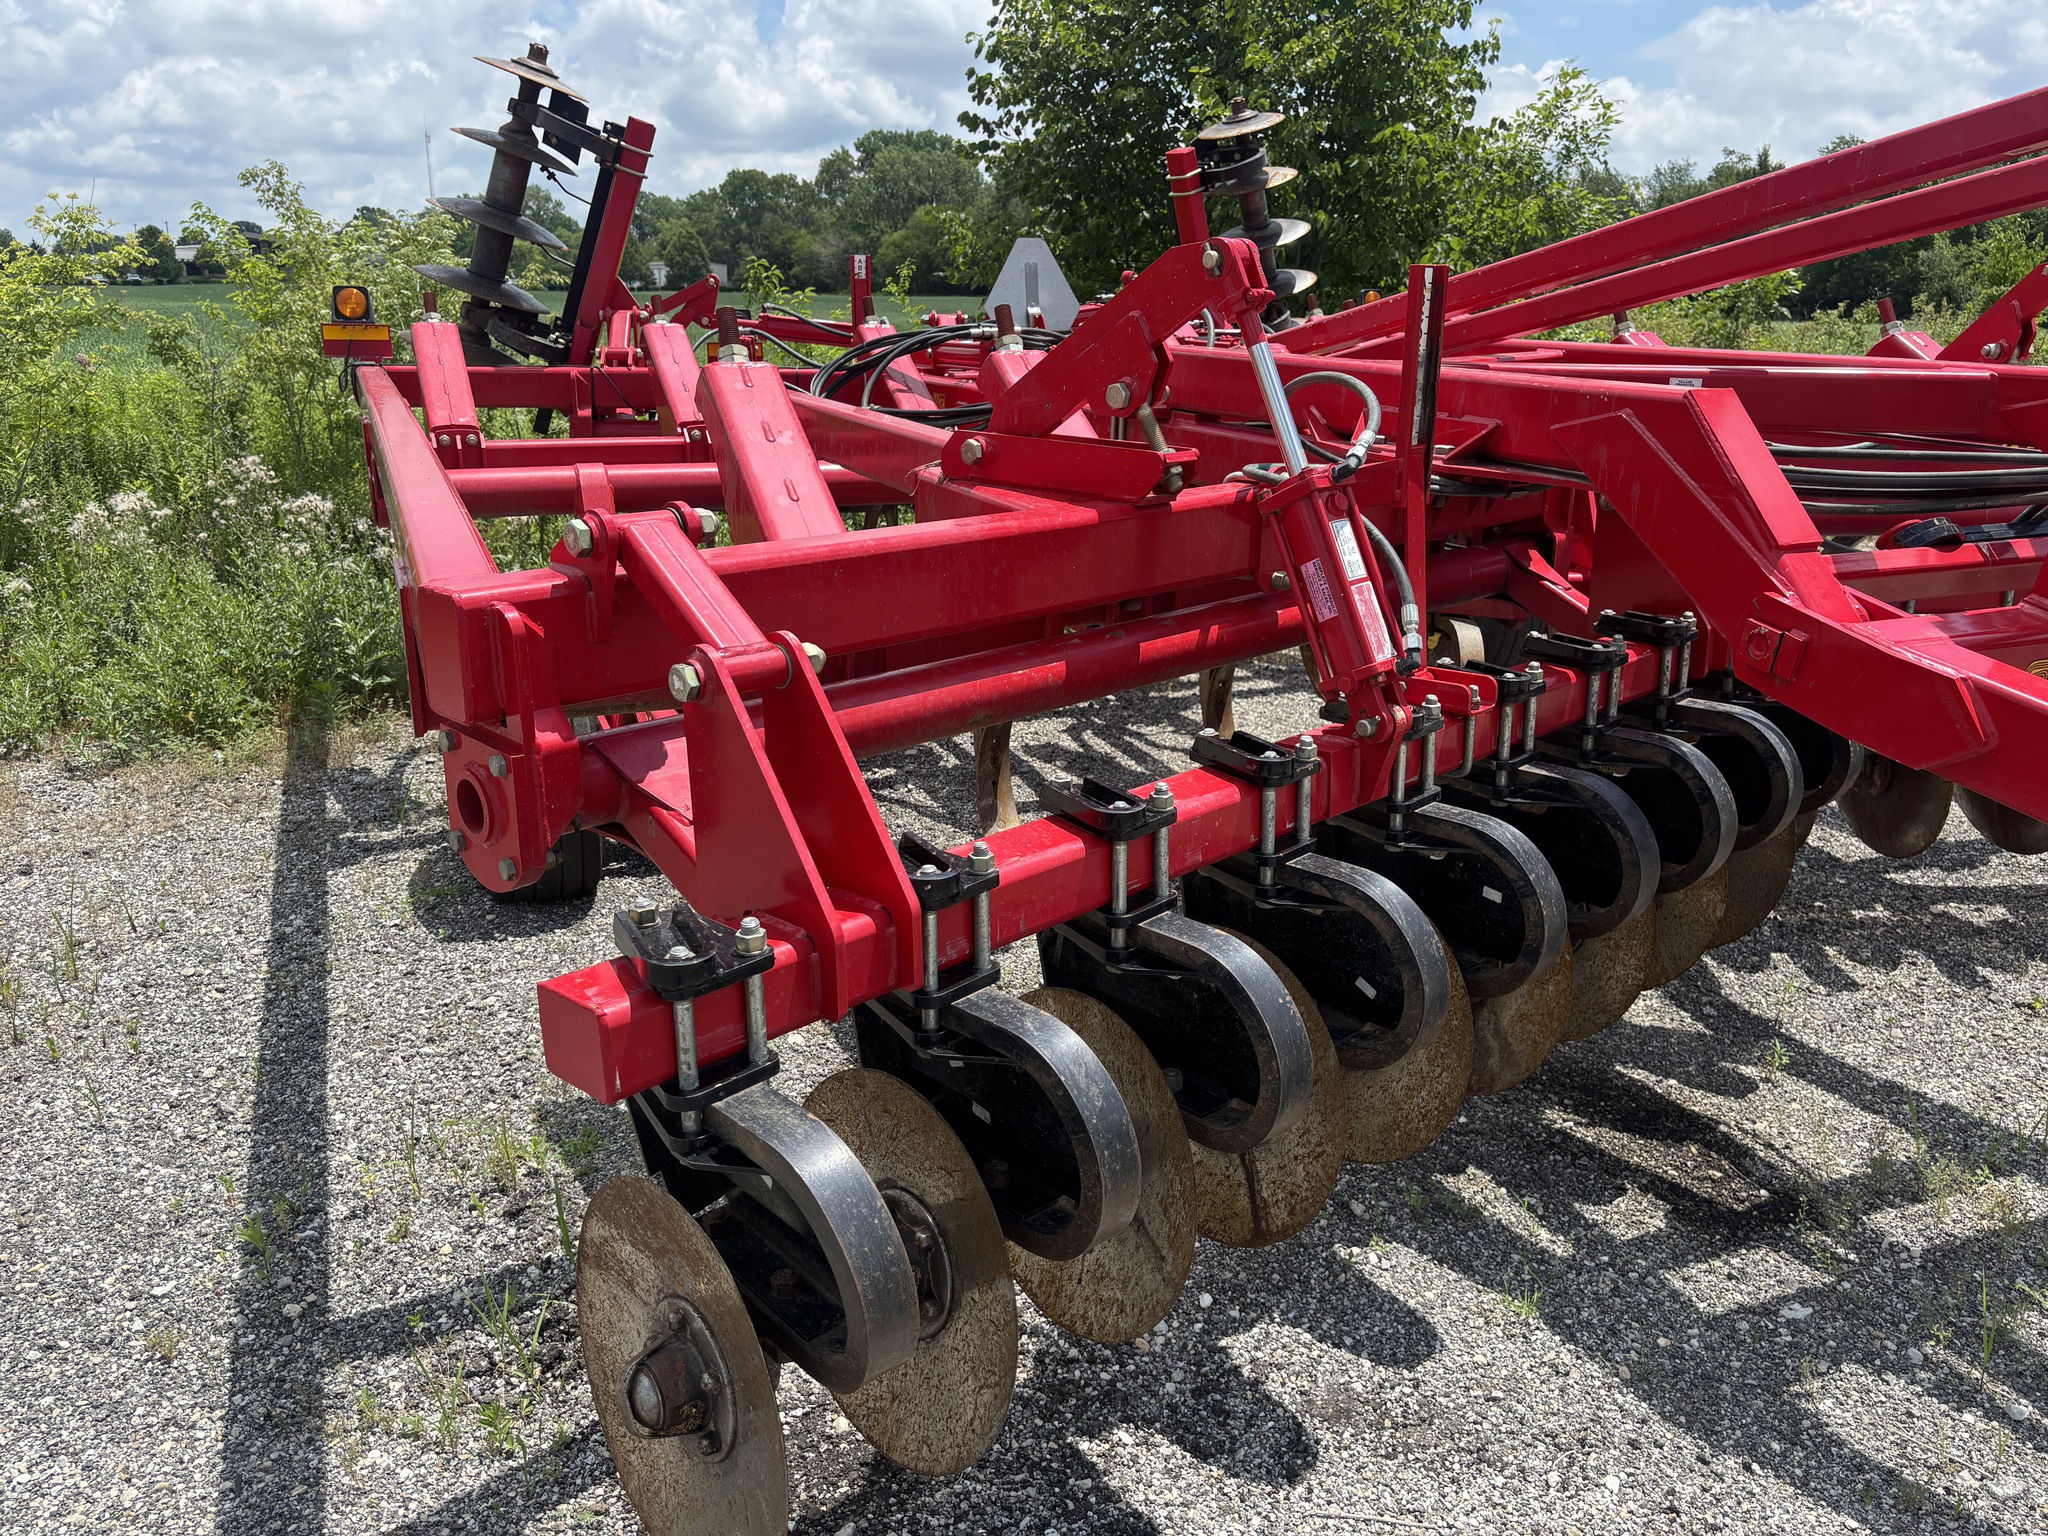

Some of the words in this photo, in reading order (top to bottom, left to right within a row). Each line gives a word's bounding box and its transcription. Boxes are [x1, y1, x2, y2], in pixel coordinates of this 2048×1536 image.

[1312, 561, 1321, 582] SERVICE
[1315, 559, 1327, 585] COMPLETE
[1324, 586, 1337, 615] HYDRAULIC
